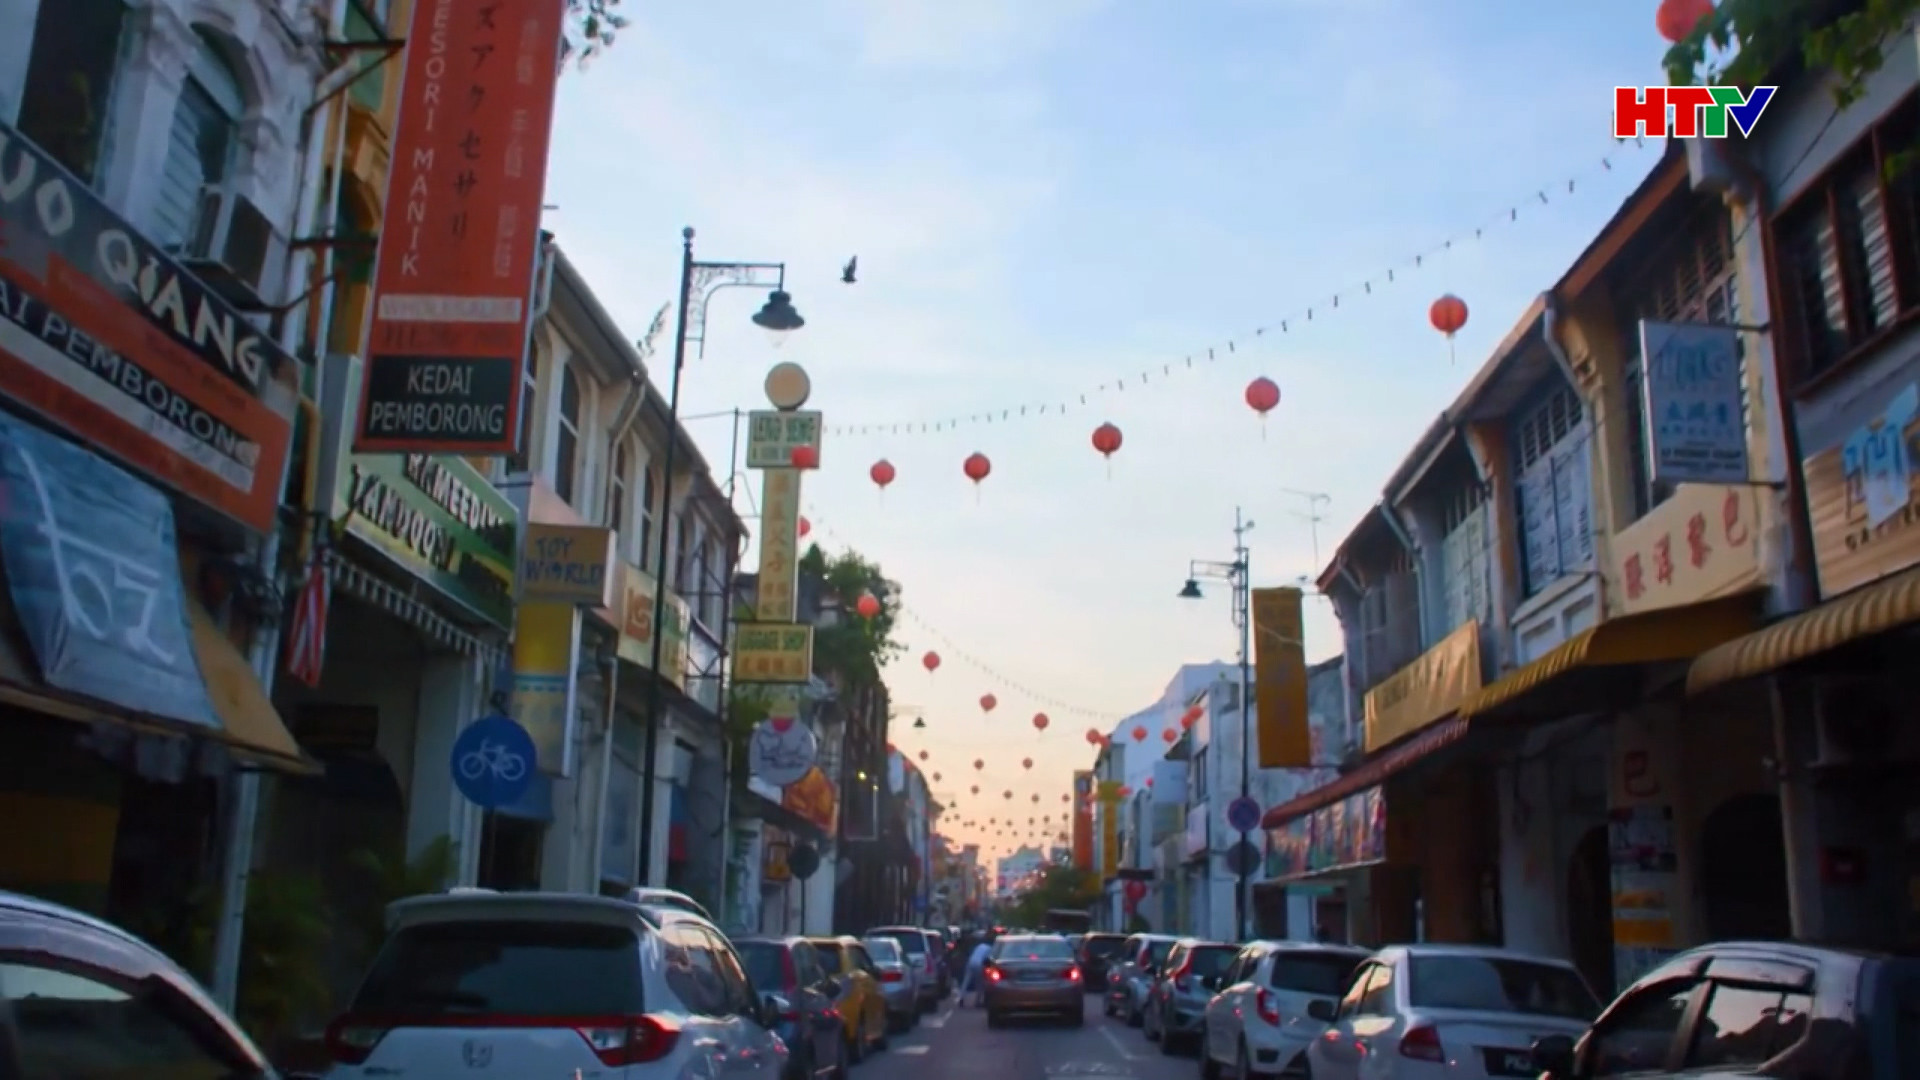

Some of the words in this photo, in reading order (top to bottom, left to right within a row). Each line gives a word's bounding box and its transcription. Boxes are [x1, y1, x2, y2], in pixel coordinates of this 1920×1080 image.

[423, 0, 451, 131] ESORI
[402, 148, 435, 277] MANIK
[407, 363, 474, 396] KEDAI
[369, 401, 505, 435] PEMBORONG
[537, 535, 573, 559] TOY
[526, 560, 606, 586] WORLD
